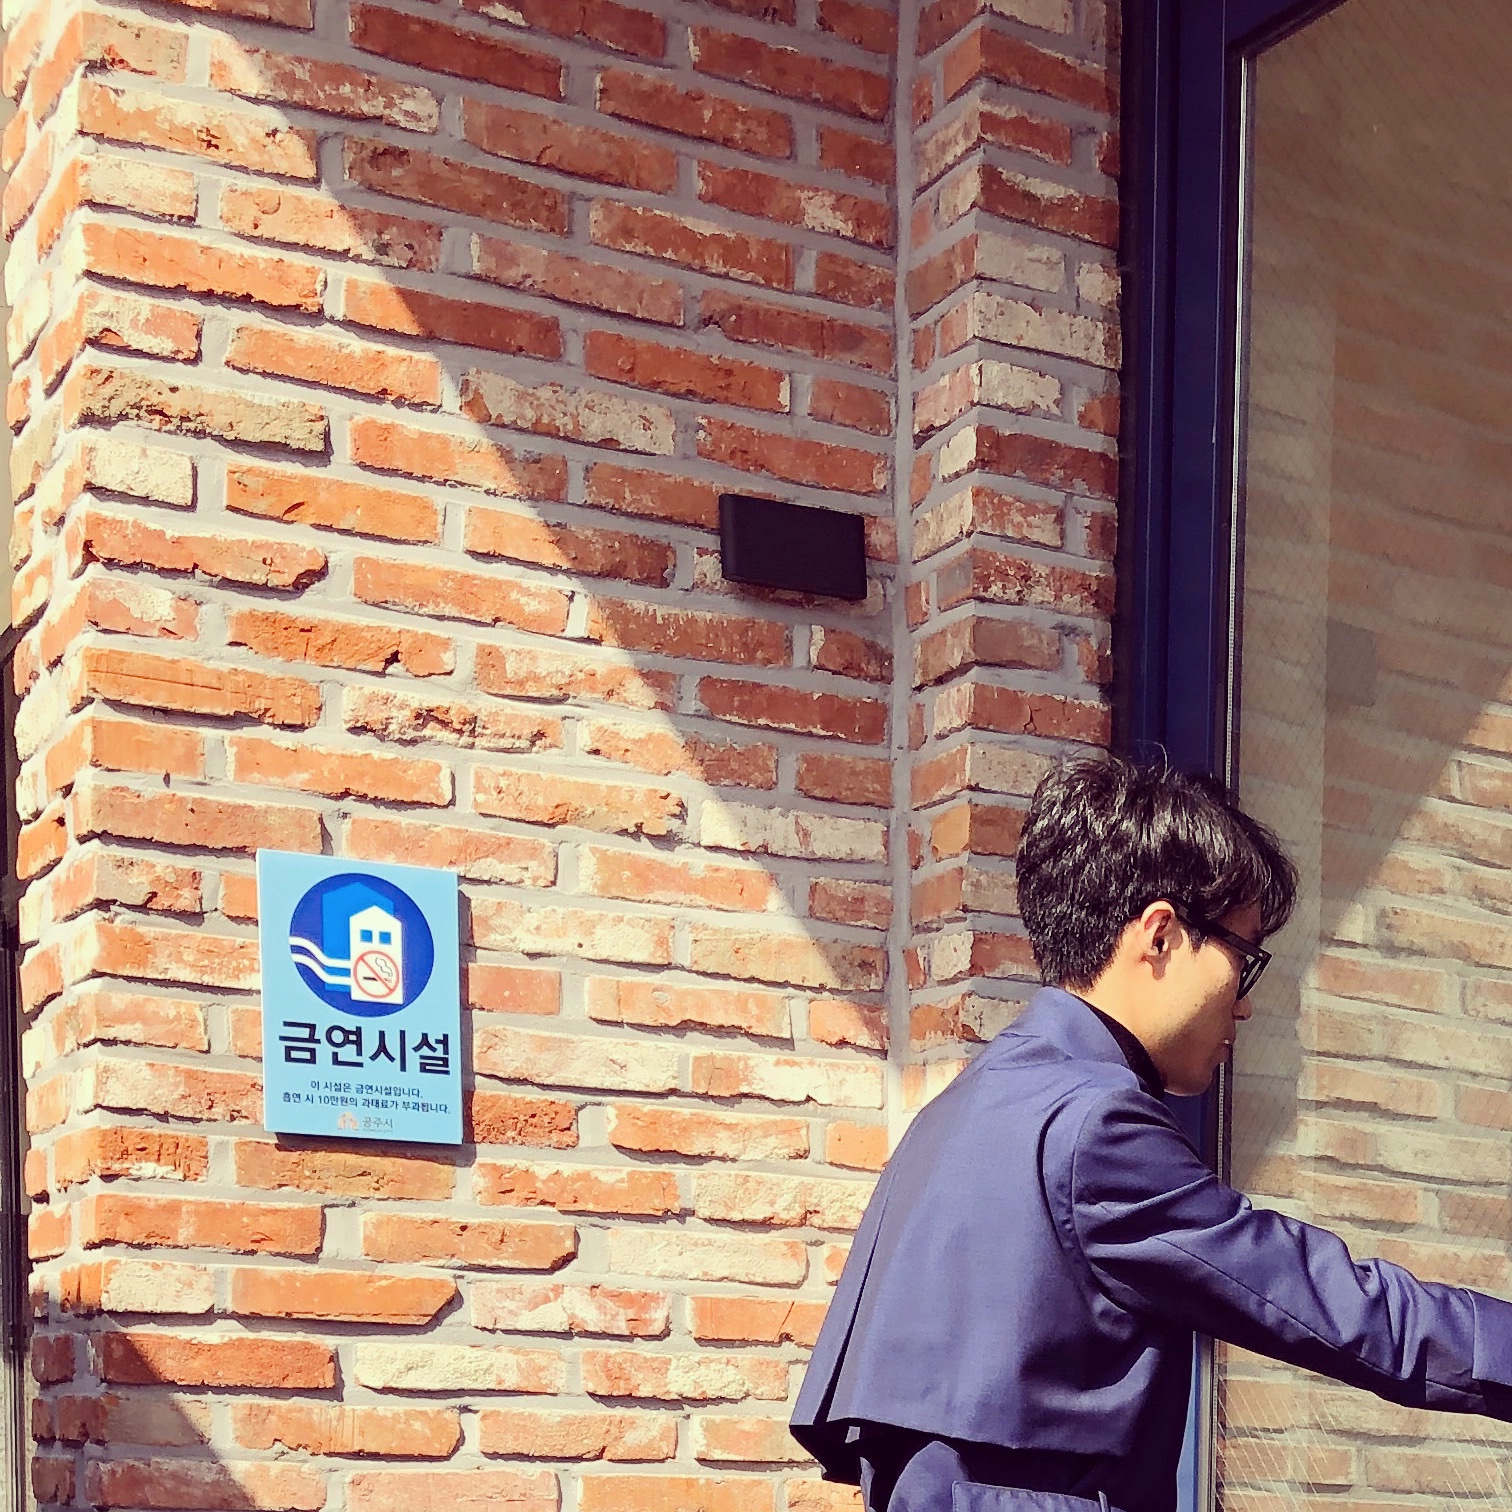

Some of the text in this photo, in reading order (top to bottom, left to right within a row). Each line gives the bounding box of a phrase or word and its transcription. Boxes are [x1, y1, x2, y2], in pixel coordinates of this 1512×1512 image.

[279, 1020, 450, 1076] 금연시설
[310, 1080, 423, 1098] 이 시설은 금연시설입니다.
[282, 1091, 302, 1104] 흡연
[304, 1093, 314, 1104] 시
[318, 1095, 358, 1107] 10만원의
[401, 1100, 451, 1115] 부과됩니다.
[362, 1116, 394, 1129] 공주시
